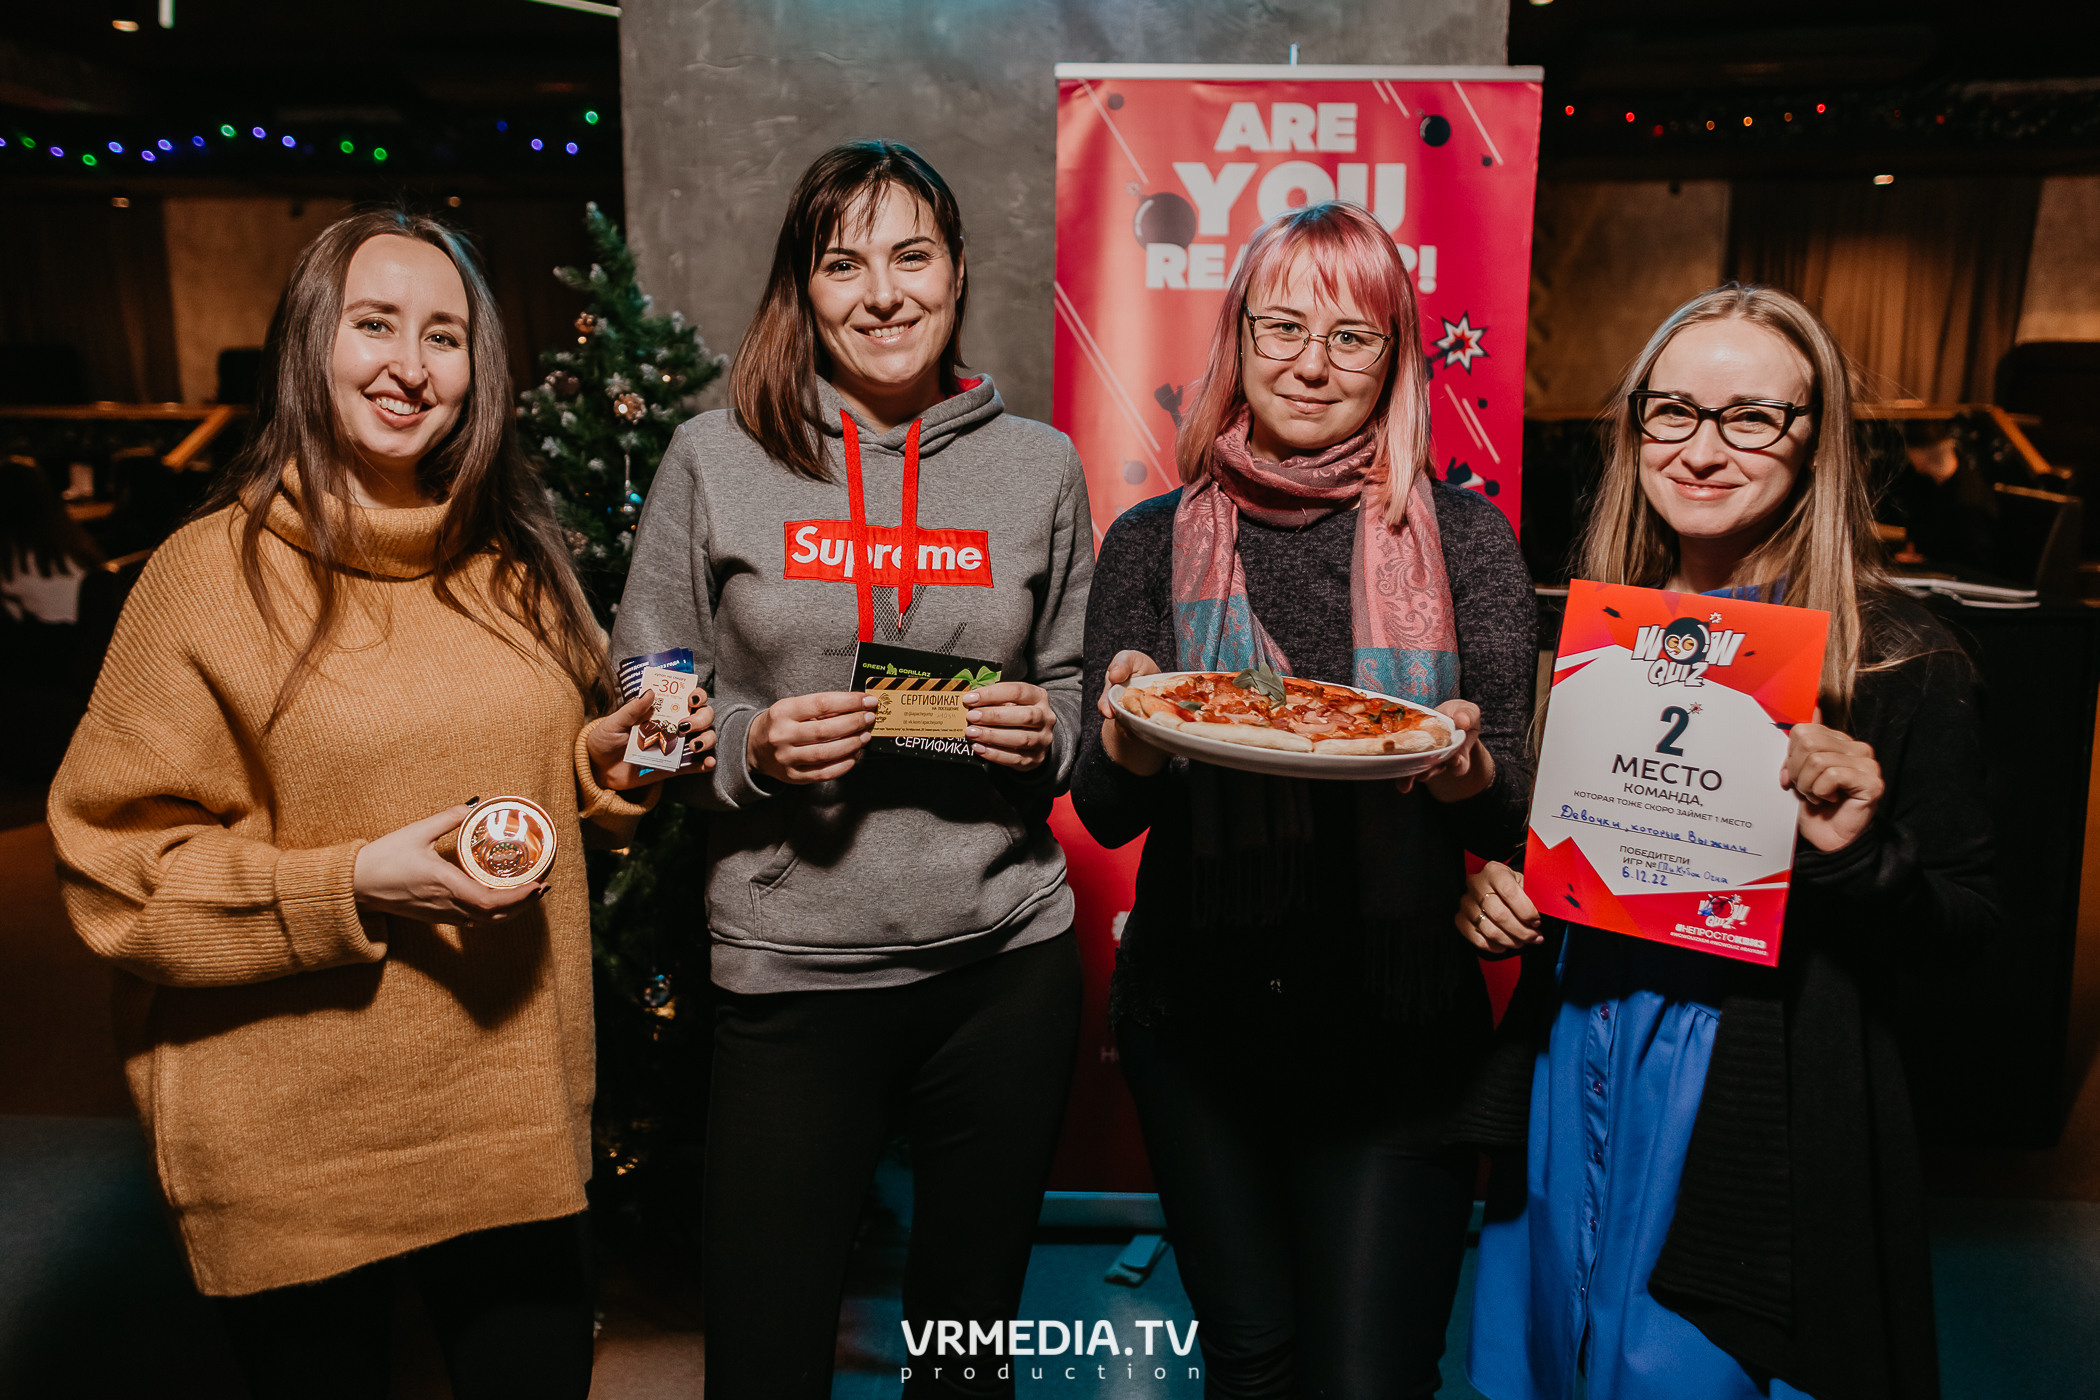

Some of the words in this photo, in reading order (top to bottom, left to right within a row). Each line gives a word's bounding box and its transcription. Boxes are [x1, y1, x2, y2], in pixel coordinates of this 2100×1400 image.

[1214, 102, 1357, 153] ARE
[1173, 160, 1406, 236] YOU
[791, 525, 982, 578] Supreme
[1631, 617, 1746, 666] WOW
[862, 662, 886, 670] GREEN
[898, 668, 931, 678] GORILLAZ
[1648, 659, 1709, 687] QUIZ
[901, 694, 960, 706] СЕРТИФИКАТ
[1655, 705, 1689, 757] 2
[1611, 754, 1722, 791] МЕСТО
[1573, 790, 1615, 803] КОТОРАЯ
[1616, 797, 1643, 809] ТОЖЕ
[1644, 802, 1674, 814] СКОРО
[1676, 809, 1713, 821] ЗАЙМЕТ
[1720, 816, 1753, 829] МЕСТО
[1631, 824, 1681, 840] которые
[1619, 845, 1690, 865] ПОБЕДИТЕЛИ
[1623, 857, 1643, 866] ИГР
[1622, 866, 1668, 886] 6.12.22
[1705, 915, 1733, 929] QUIZ
